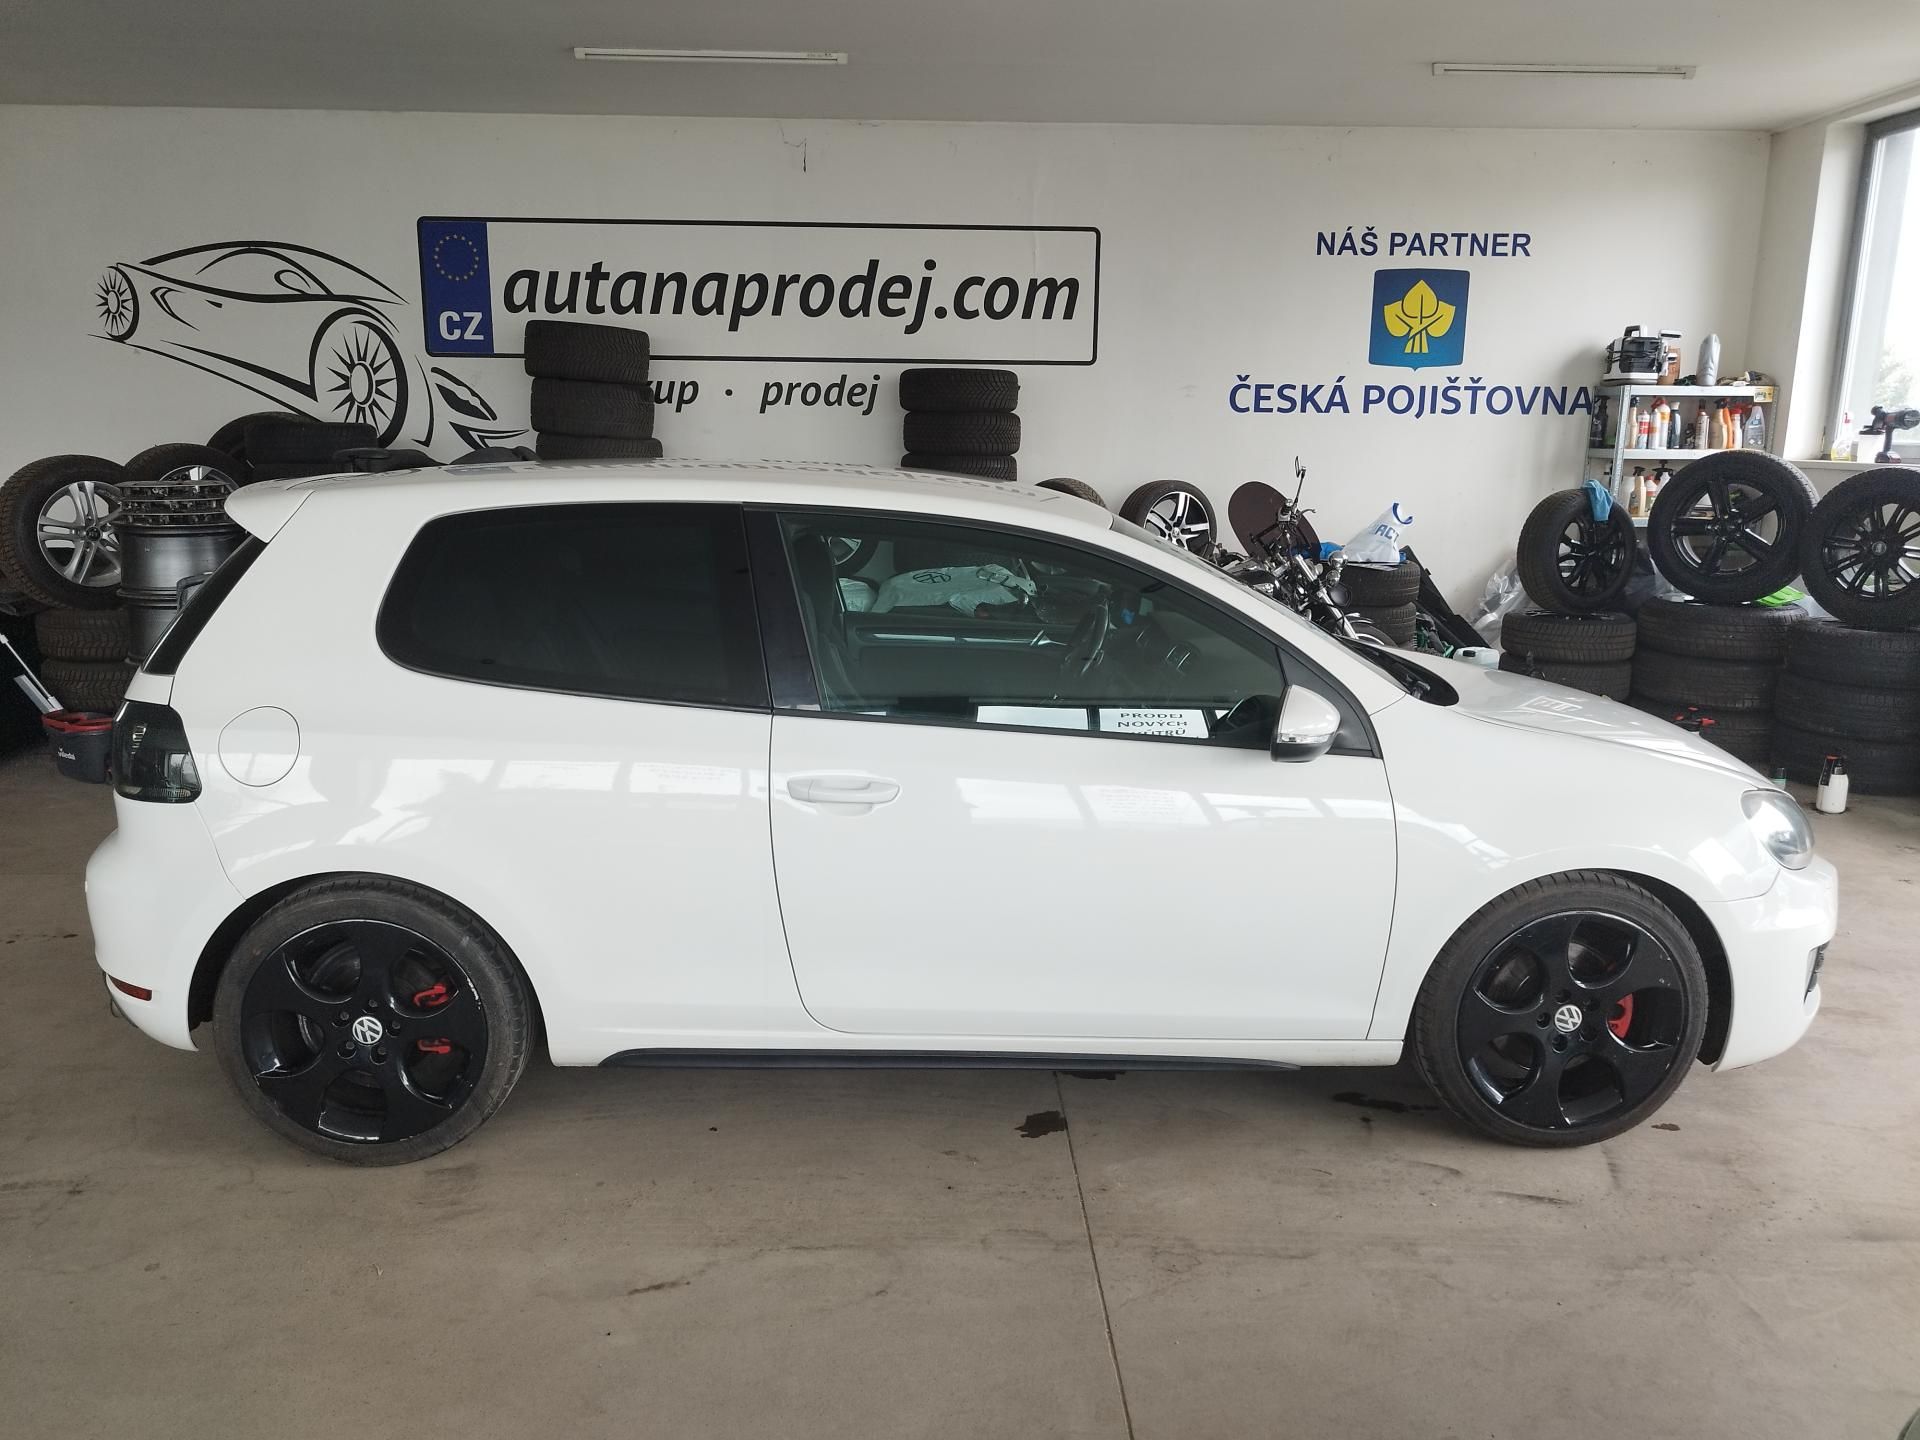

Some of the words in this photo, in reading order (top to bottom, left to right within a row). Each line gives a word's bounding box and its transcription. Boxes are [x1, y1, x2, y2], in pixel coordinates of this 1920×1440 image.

[1316, 225, 1378, 257] NÁŠ
[1389, 232, 1532, 257] PARTNER
[503, 258, 1080, 335] autanaprodej.com
[438, 311, 484, 341] CZ
[648, 380, 699, 413] up
[759, 373, 881, 416] prodej
[1229, 374, 1350, 414] ČESKÁ
[1362, 376, 1594, 420] POJIŠŤOVNA
[1118, 719, 1188, 728] NOVÝCH
